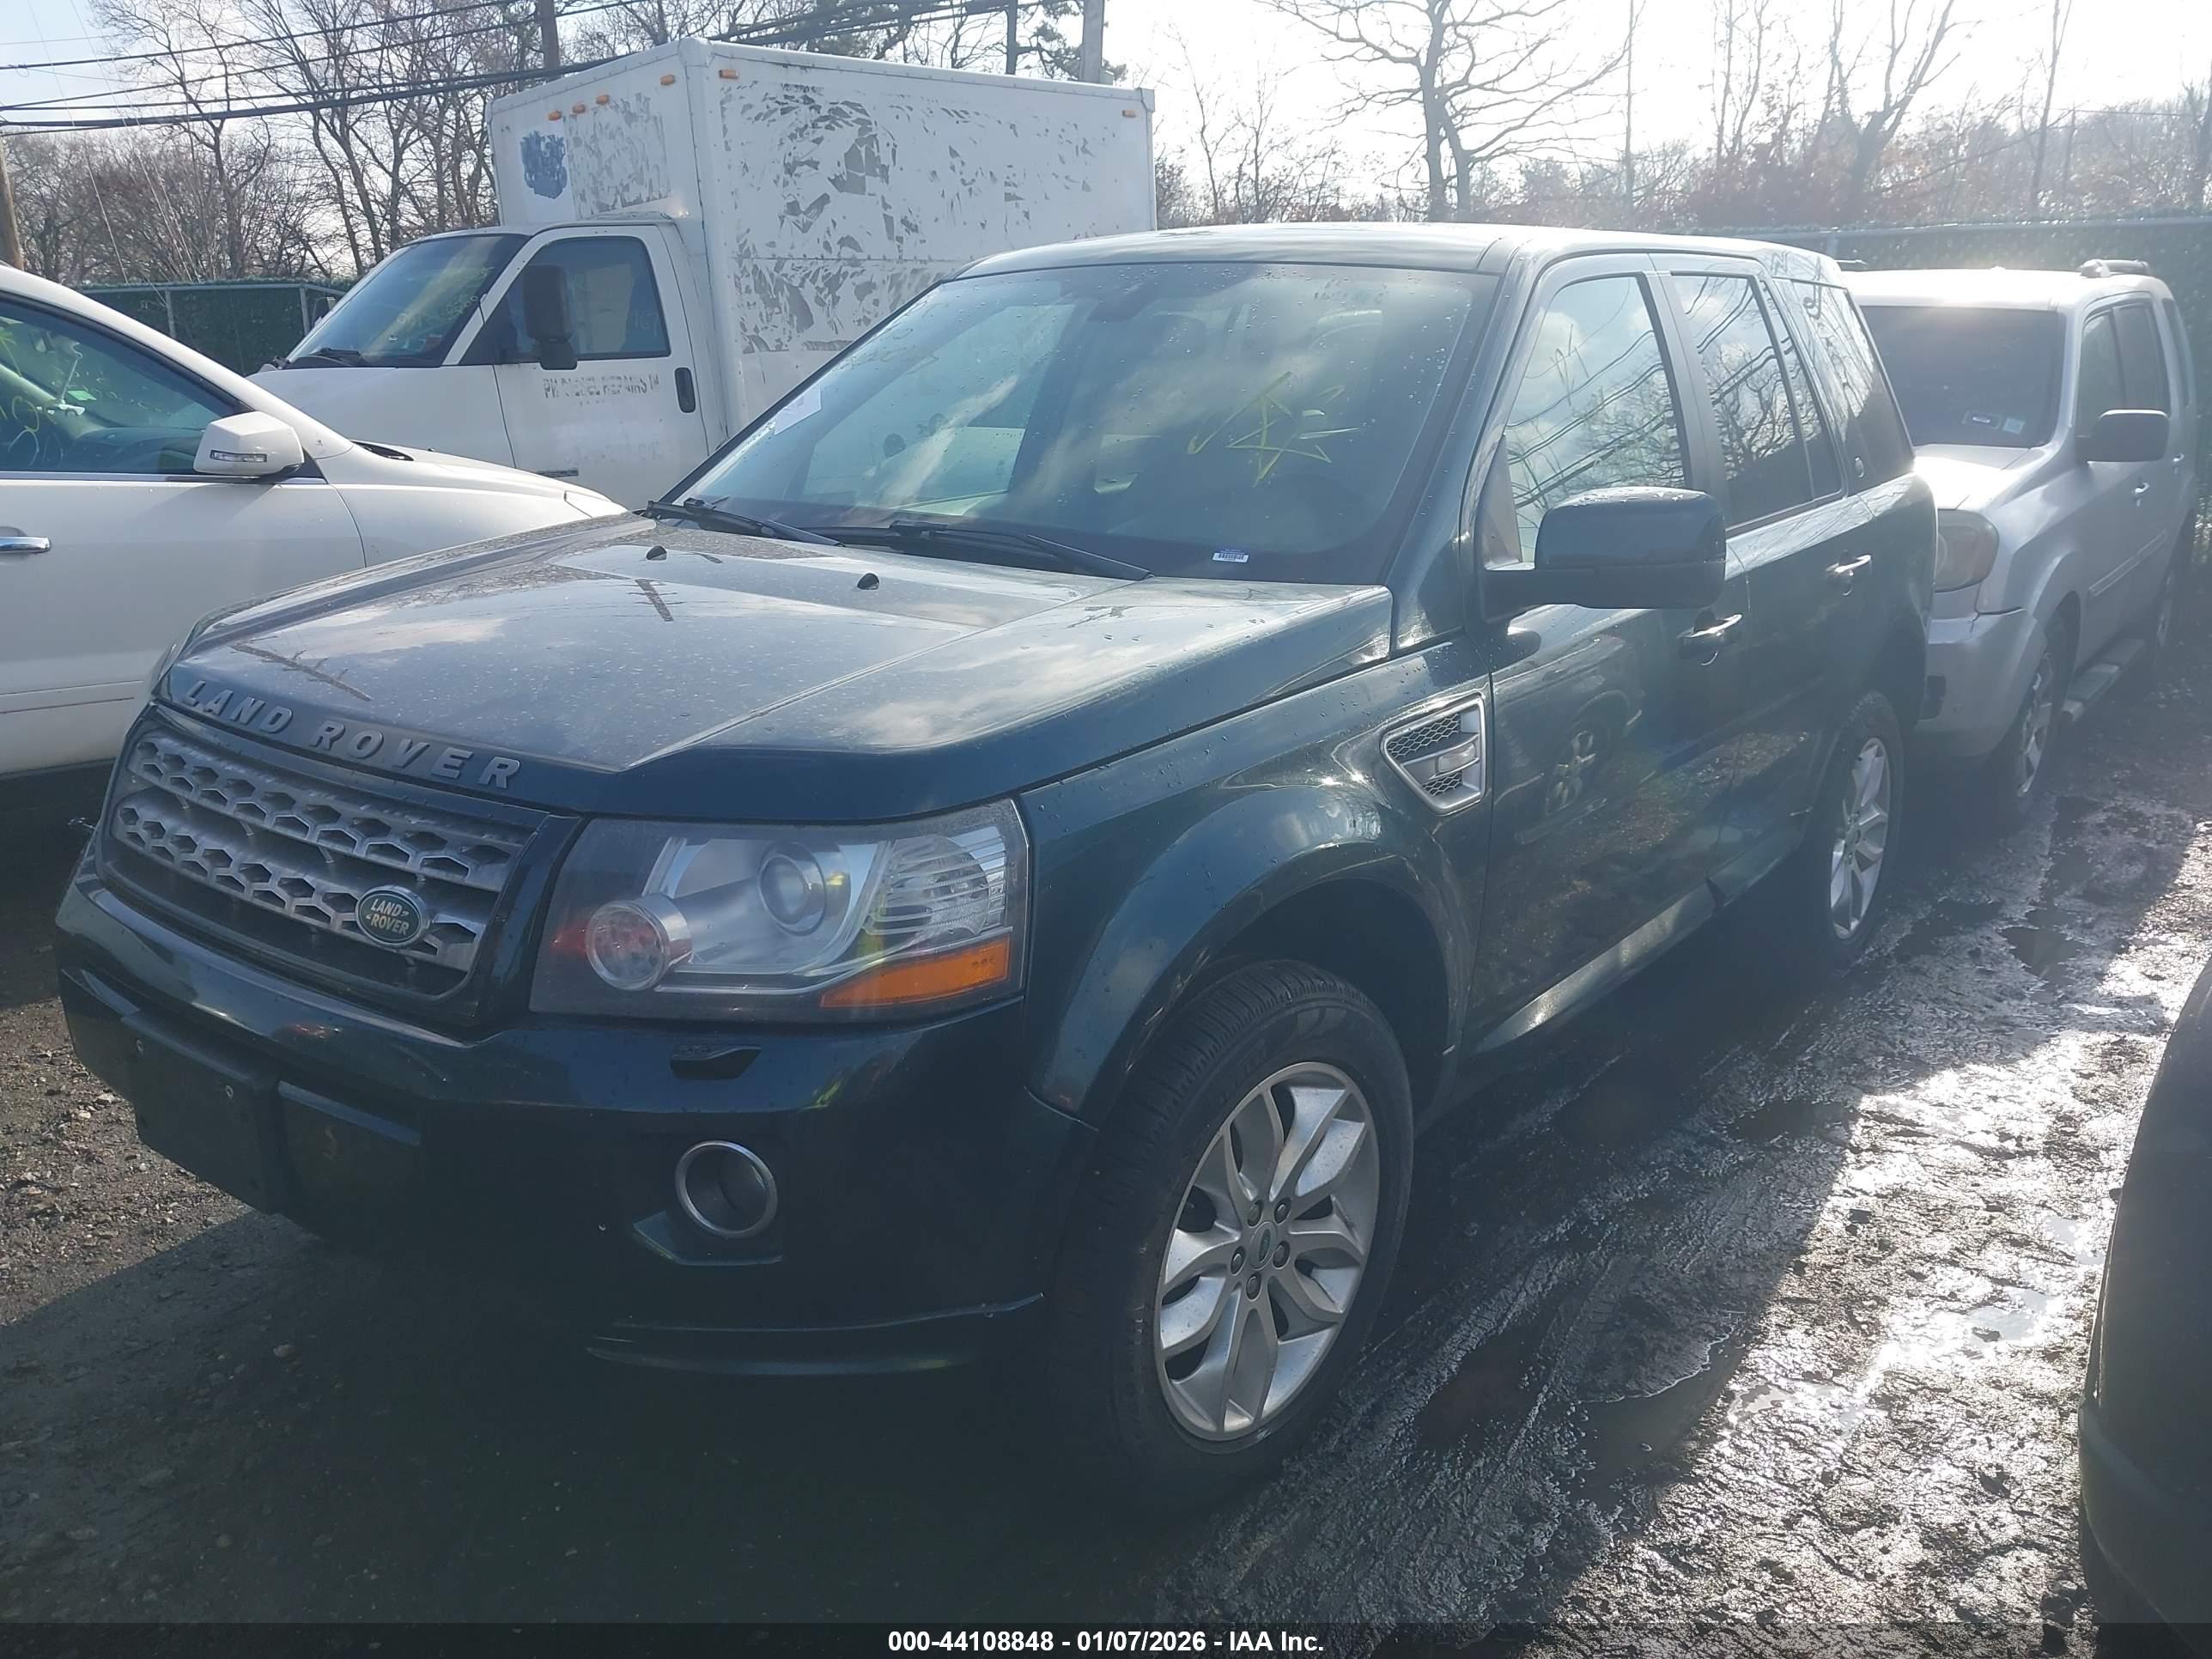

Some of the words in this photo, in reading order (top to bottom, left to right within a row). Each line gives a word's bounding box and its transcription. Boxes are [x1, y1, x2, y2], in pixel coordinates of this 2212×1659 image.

[181, 680, 294, 734] LAND
[310, 720, 521, 789] ROVER
[370, 898, 403, 917] LAND
[370, 913, 410, 935] ROVER
